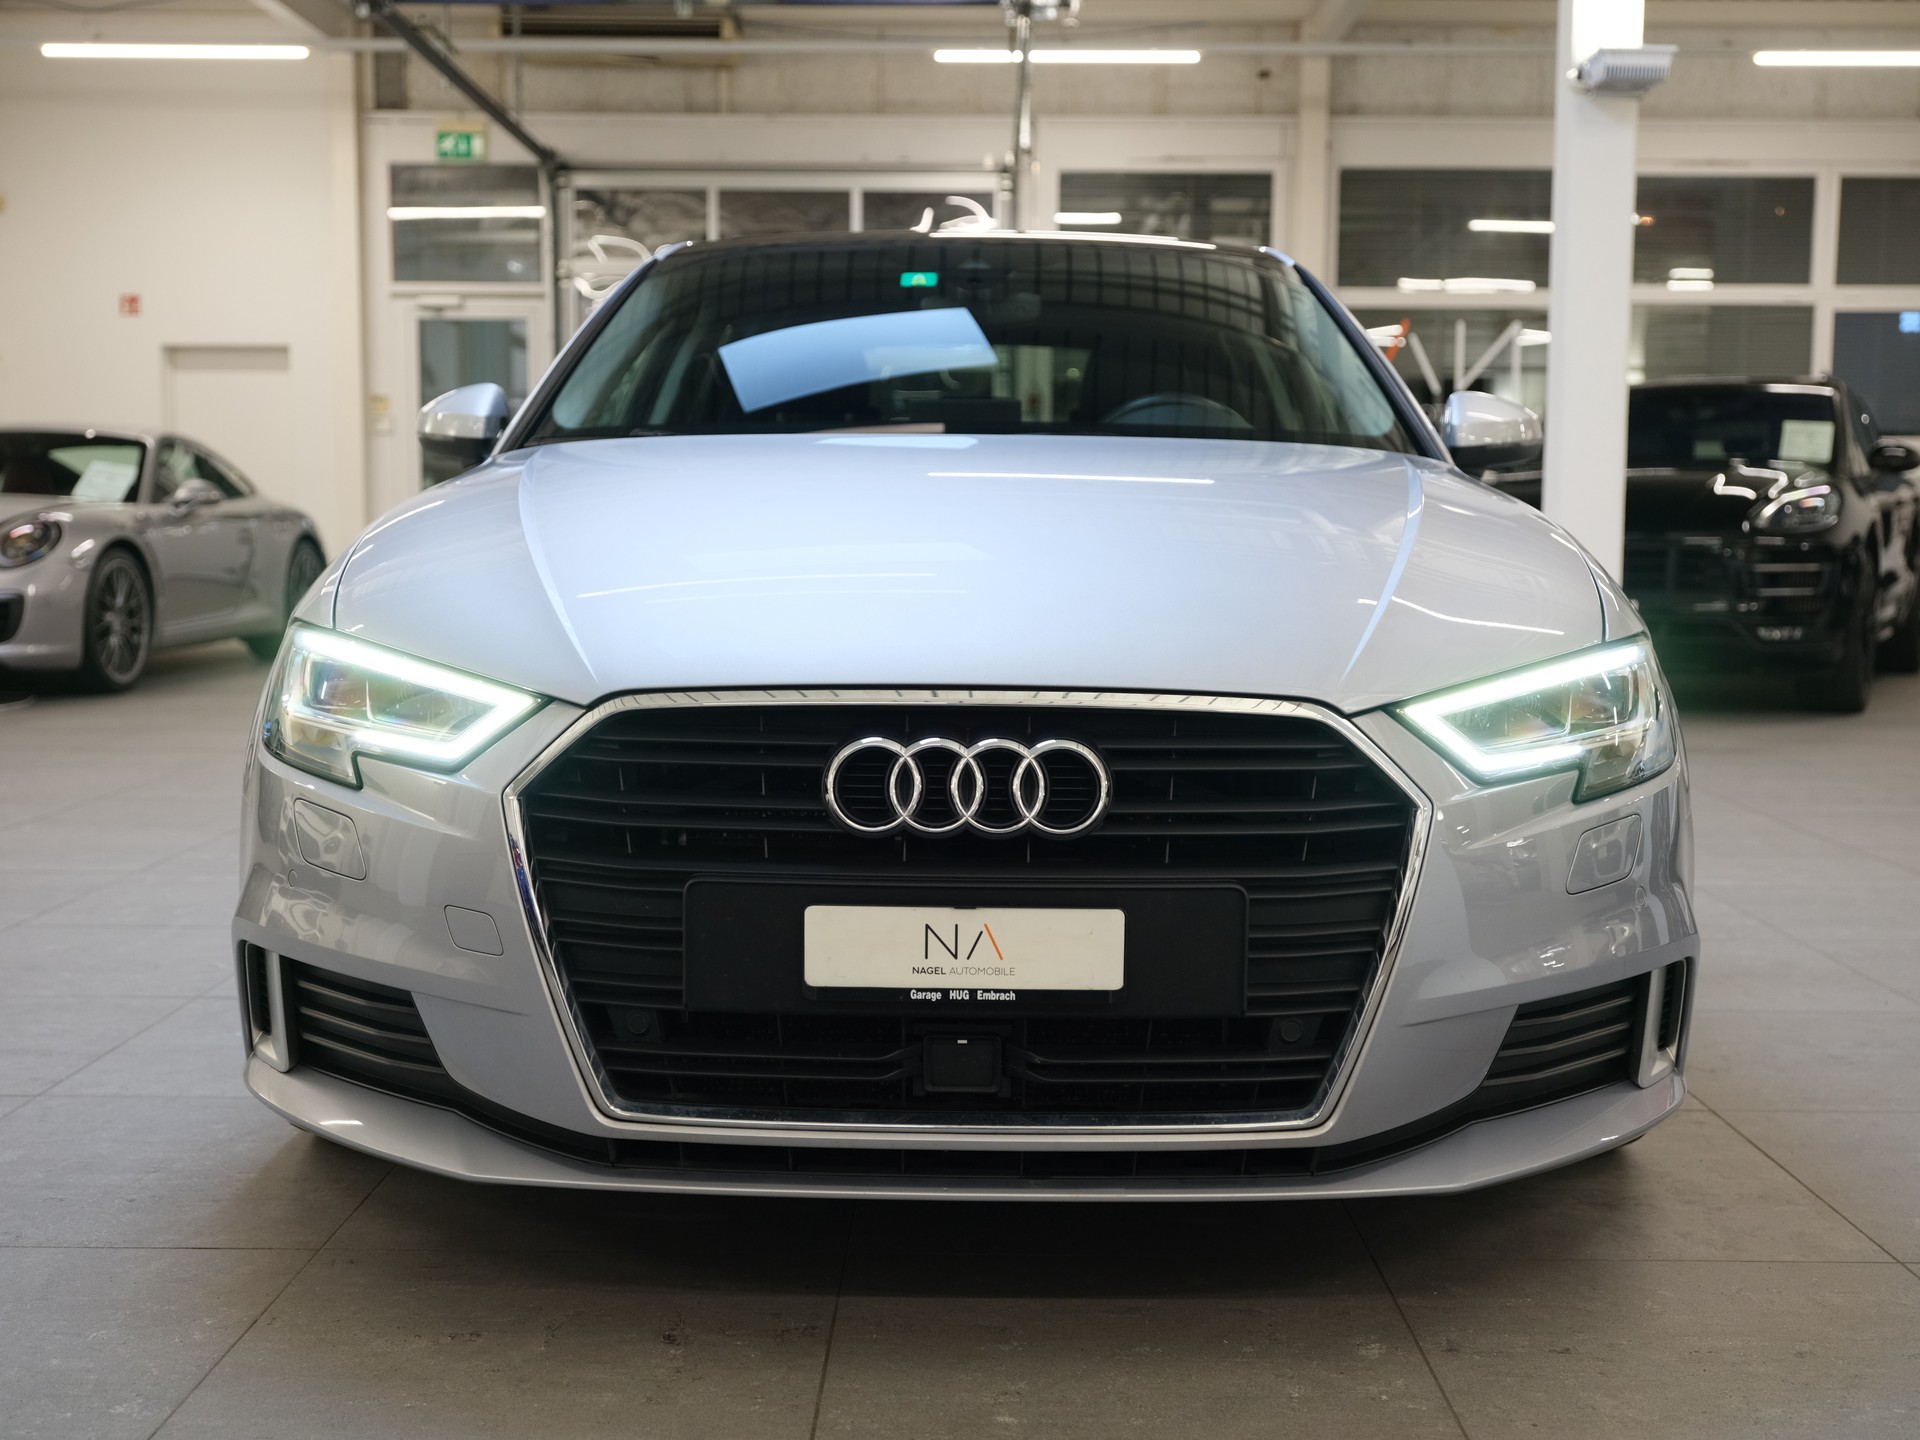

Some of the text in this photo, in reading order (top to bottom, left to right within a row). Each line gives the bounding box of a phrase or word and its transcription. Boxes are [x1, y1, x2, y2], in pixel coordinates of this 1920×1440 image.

[912, 966, 1016, 976] NAGEL AUTOMOBILE
[910, 989, 1016, 1001] Garage HUG Embrach
